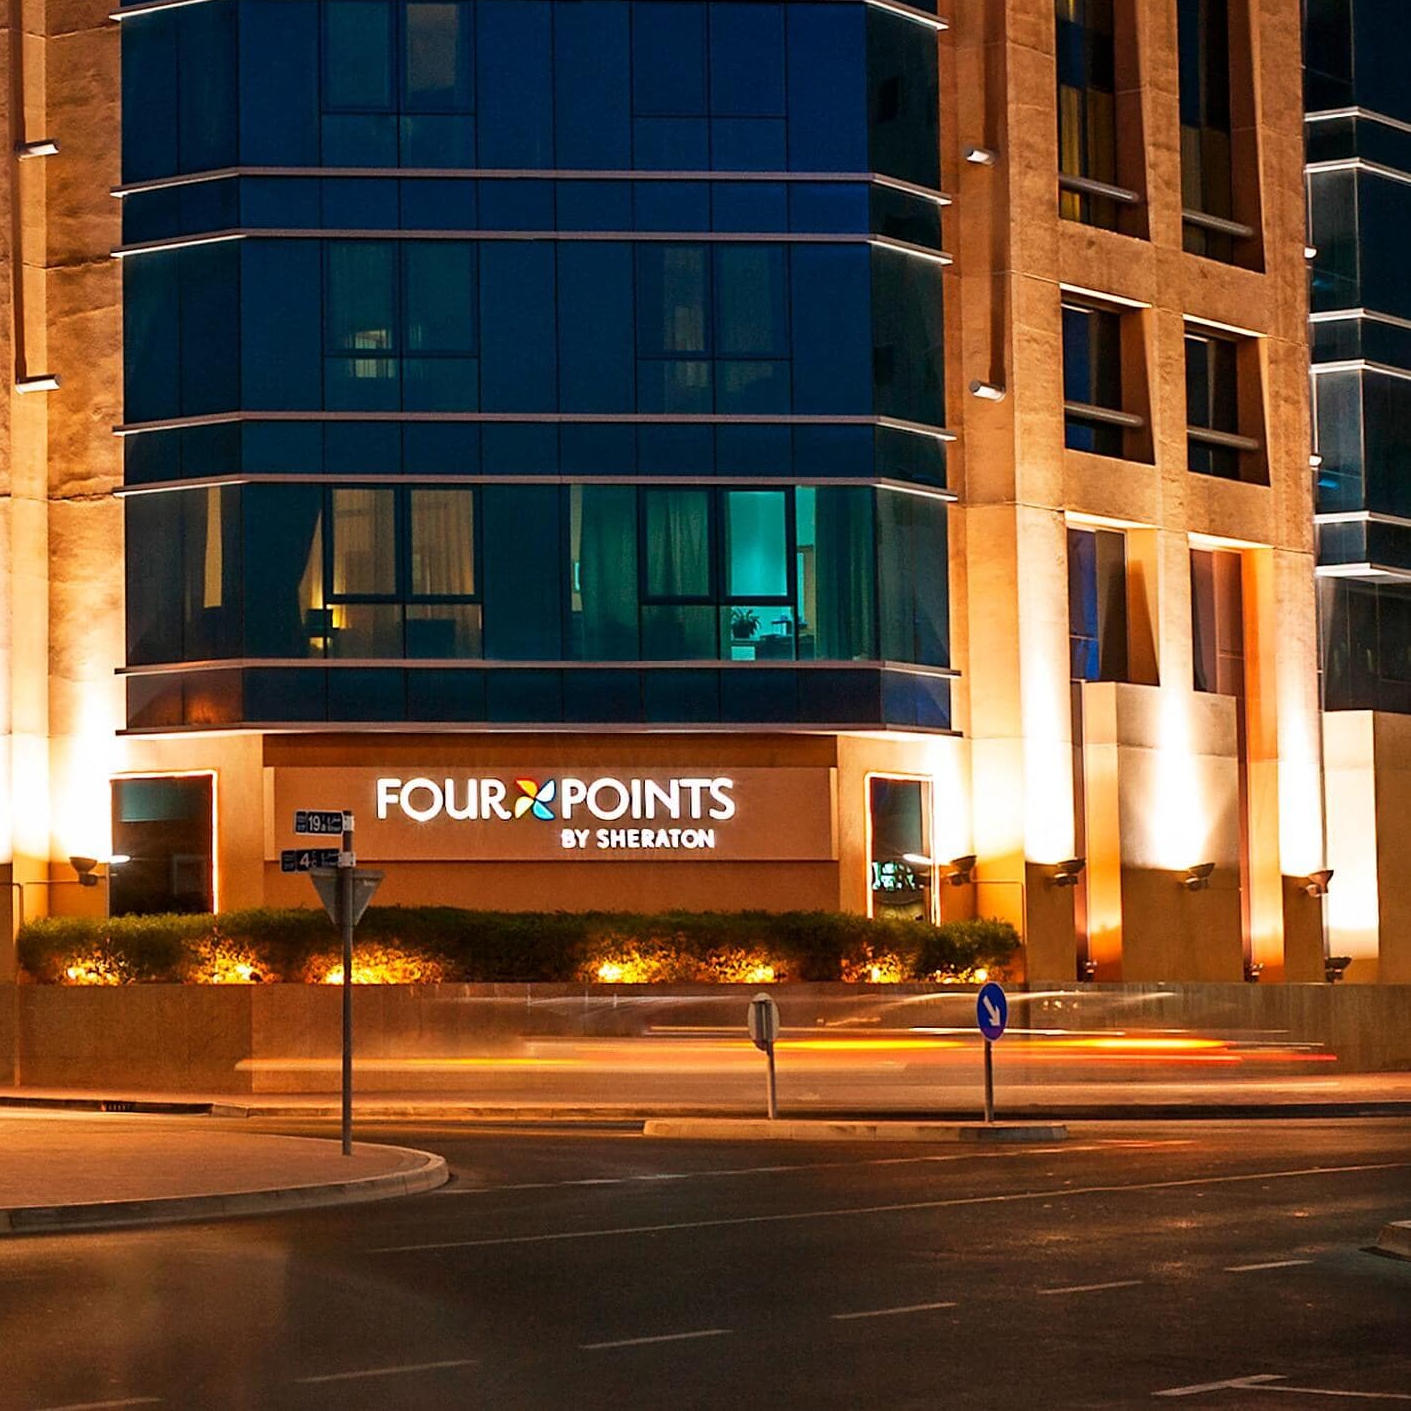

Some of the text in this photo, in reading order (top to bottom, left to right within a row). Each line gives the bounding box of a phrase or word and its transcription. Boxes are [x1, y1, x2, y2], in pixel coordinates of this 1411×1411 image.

[376, 776, 736, 822] FOUR POINTS
[308, 815, 321, 832] 19
[560, 829, 716, 849] BY SHERATON
[299, 853, 310, 868] 4
